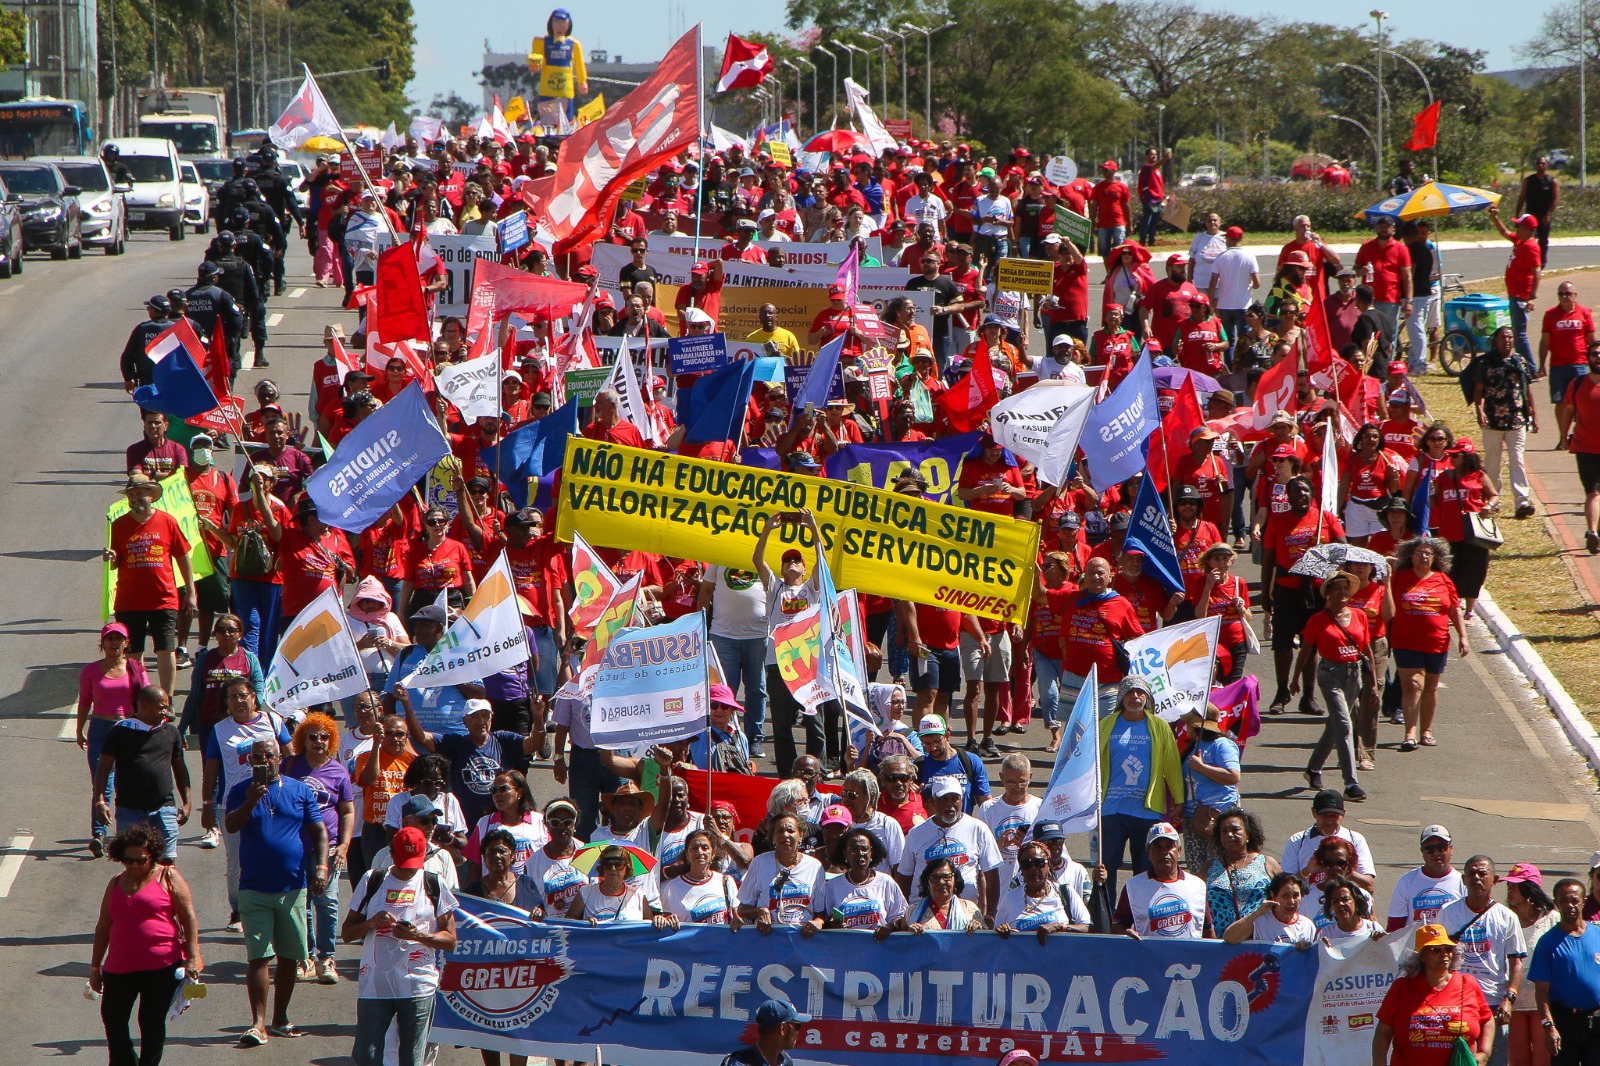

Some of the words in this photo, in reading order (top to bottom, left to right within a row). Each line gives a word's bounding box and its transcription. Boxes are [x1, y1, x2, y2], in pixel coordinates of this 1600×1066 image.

[1000, 268, 1017, 276] CHEGA
[1026, 269, 1050, 279] CONFISCO
[1000, 276, 1010, 284] DOS
[1011, 277, 1050, 286] APOSENTADOS!
[673, 350, 714, 360] TRABALHADOR
[682, 356, 715, 367] EDUCAÇÃO!
[323, 375, 340, 384] CU
[567, 378, 602, 391] EDUCAÇÃO
[874, 375, 888, 399] MAIS
[571, 444, 624, 481] NÃO
[630, 455, 671, 488] HÁ
[674, 462, 807, 509] EDUCAÇÃO
[816, 484, 928, 534] PÚBLICA
[936, 513, 996, 548] SEM
[1271, 502, 1292, 513] UFB
[569, 482, 770, 538] VALORIZAÇÃO
[780, 517, 836, 551] DOS
[842, 528, 1016, 586] SERVIDORES
[934, 584, 1017, 619] SINDIFES
[928, 848, 954, 858] ESTAMOS
[386, 890, 416, 902] CTB
[842, 904, 870, 914] ESTAMOS
[1152, 903, 1179, 916] ESTAMOS
[1179, 902, 1188, 910] EM
[1416, 898, 1442, 909] ESTAMOS
[695, 904, 719, 918] ESTAMOS
[846, 914, 876, 926] GREVE!
[1156, 914, 1186, 928] GREVE!
[452, 938, 528, 956] ESTAMOS
[530, 938, 552, 954] EM
[460, 965, 537, 990] GREVE!
[1323, 972, 1396, 994] ASSUFBA
[1322, 991, 1364, 1000] sindicato
[1366, 990, 1376, 998] de
[638, 958, 1250, 1045] REESTRUTURAÇÃO
[446, 992, 542, 1029] Reestruturação
[542, 987, 559, 1009] já!
[1349, 1016, 1374, 1026] CTB
[1410, 1014, 1452, 1023] EDUCAÇÃO
[1409, 1022, 1444, 1030] PÚBLICA
[845, 1029, 1016, 1052] carreira
[1039, 1030, 1104, 1060] JÁ!
